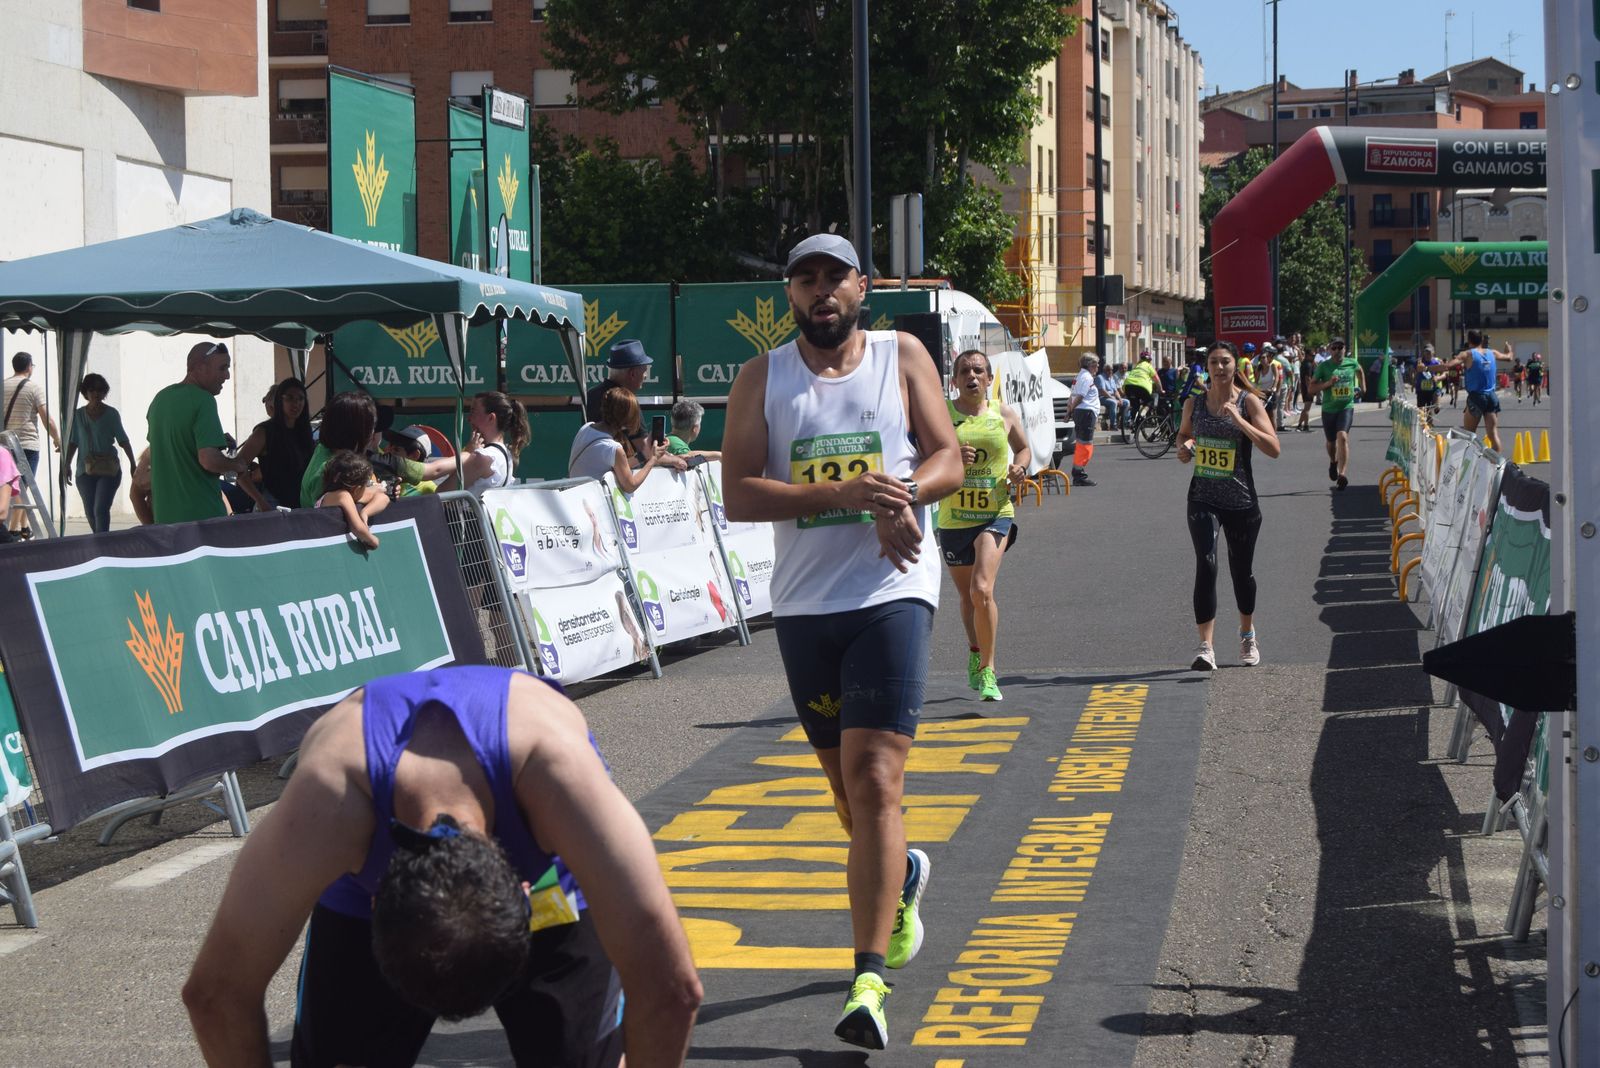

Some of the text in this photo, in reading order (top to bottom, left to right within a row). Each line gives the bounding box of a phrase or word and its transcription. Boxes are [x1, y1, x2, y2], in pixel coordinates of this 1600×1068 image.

[1383, 148, 1422, 158] DIPUTACIÓN
[1452, 141, 1484, 155] CON
[1494, 142, 1513, 155] EL
[1382, 156, 1433, 168] ZAMORA
[1452, 161, 1534, 175] GANAMOS
[1480, 250, 1526, 267] CAJA
[1230, 319, 1266, 328] ZAMORA
[350, 366, 402, 385] CAJA
[520, 364, 574, 383] CAJA
[816, 444, 870, 456] CAJA RURAL
[1200, 449, 1229, 468] 185
[957, 489, 989, 509] 115
[193, 586, 402, 695] CAJA RURAL
[1071, 683, 1150, 743] INTERIORES
[990, 812, 1113, 902] INTEGRAL
[911, 912, 1078, 1047] REFORMA
